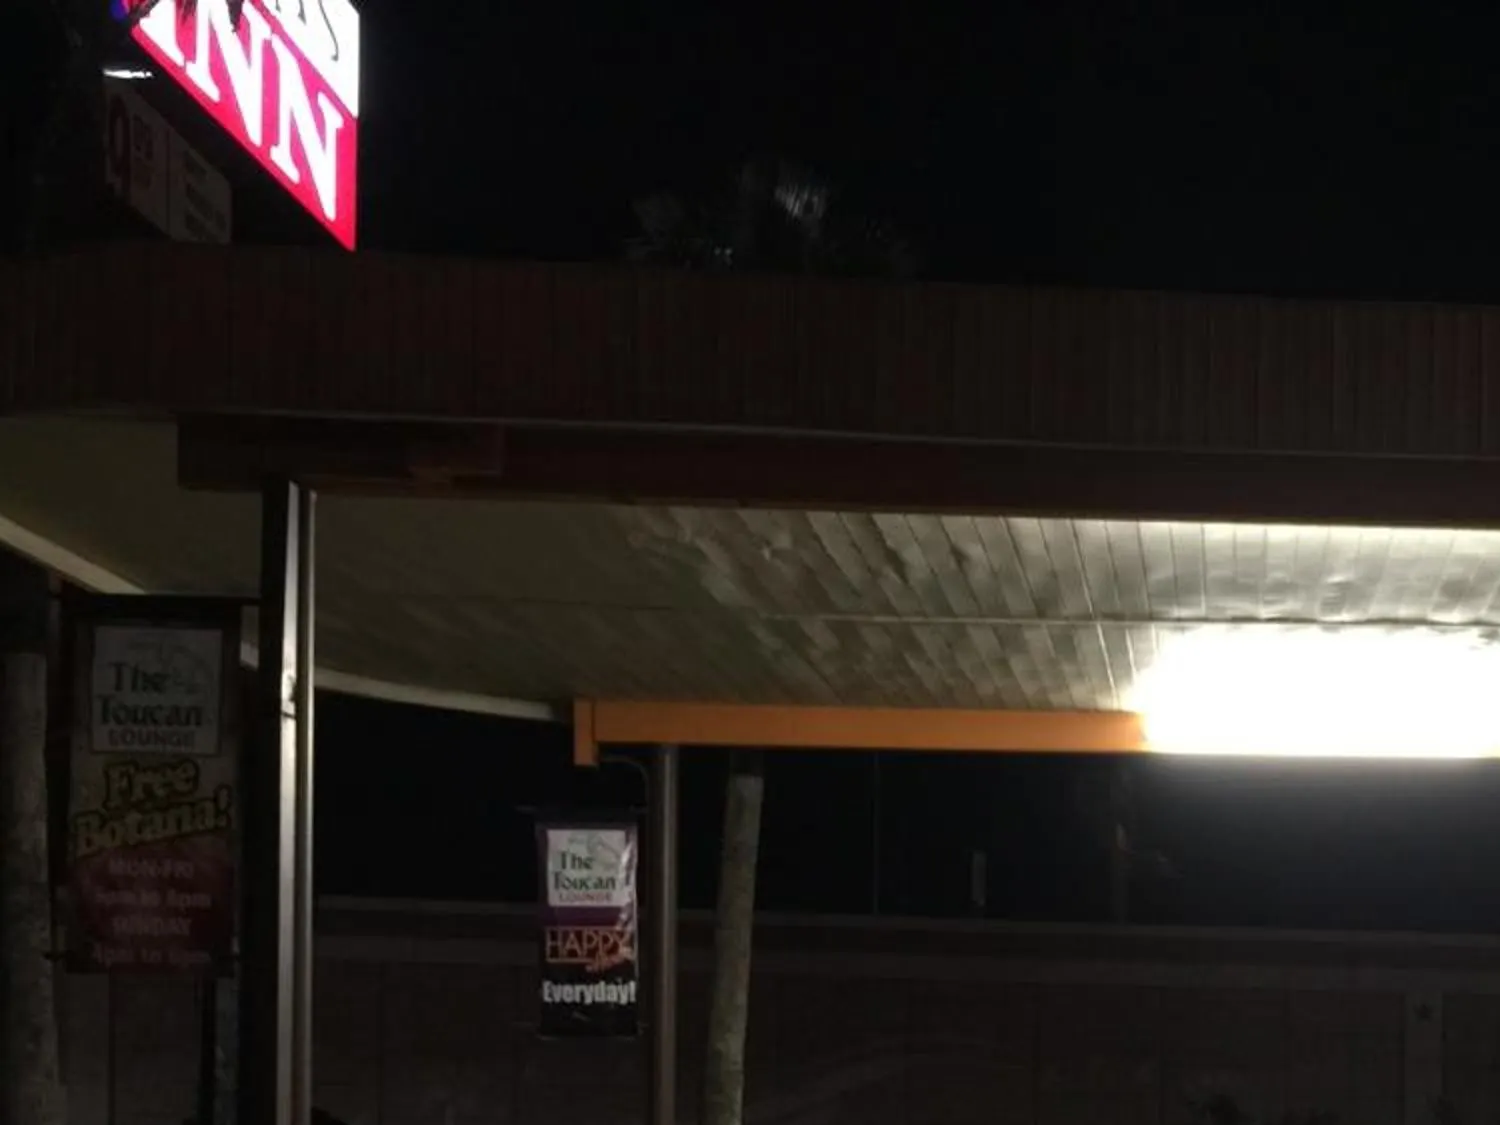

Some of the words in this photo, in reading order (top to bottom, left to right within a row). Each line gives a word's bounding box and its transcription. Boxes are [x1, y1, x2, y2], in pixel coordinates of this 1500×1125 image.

[110, 662, 168, 692] The
[96, 694, 203, 726] Toucan
[103, 760, 200, 810] Free
[73, 783, 233, 857] Botana!
[560, 851, 594, 871] The
[553, 871, 617, 892] Toucan
[545, 928, 632, 959] HAPPY
[542, 978, 637, 1006] Everyday!
